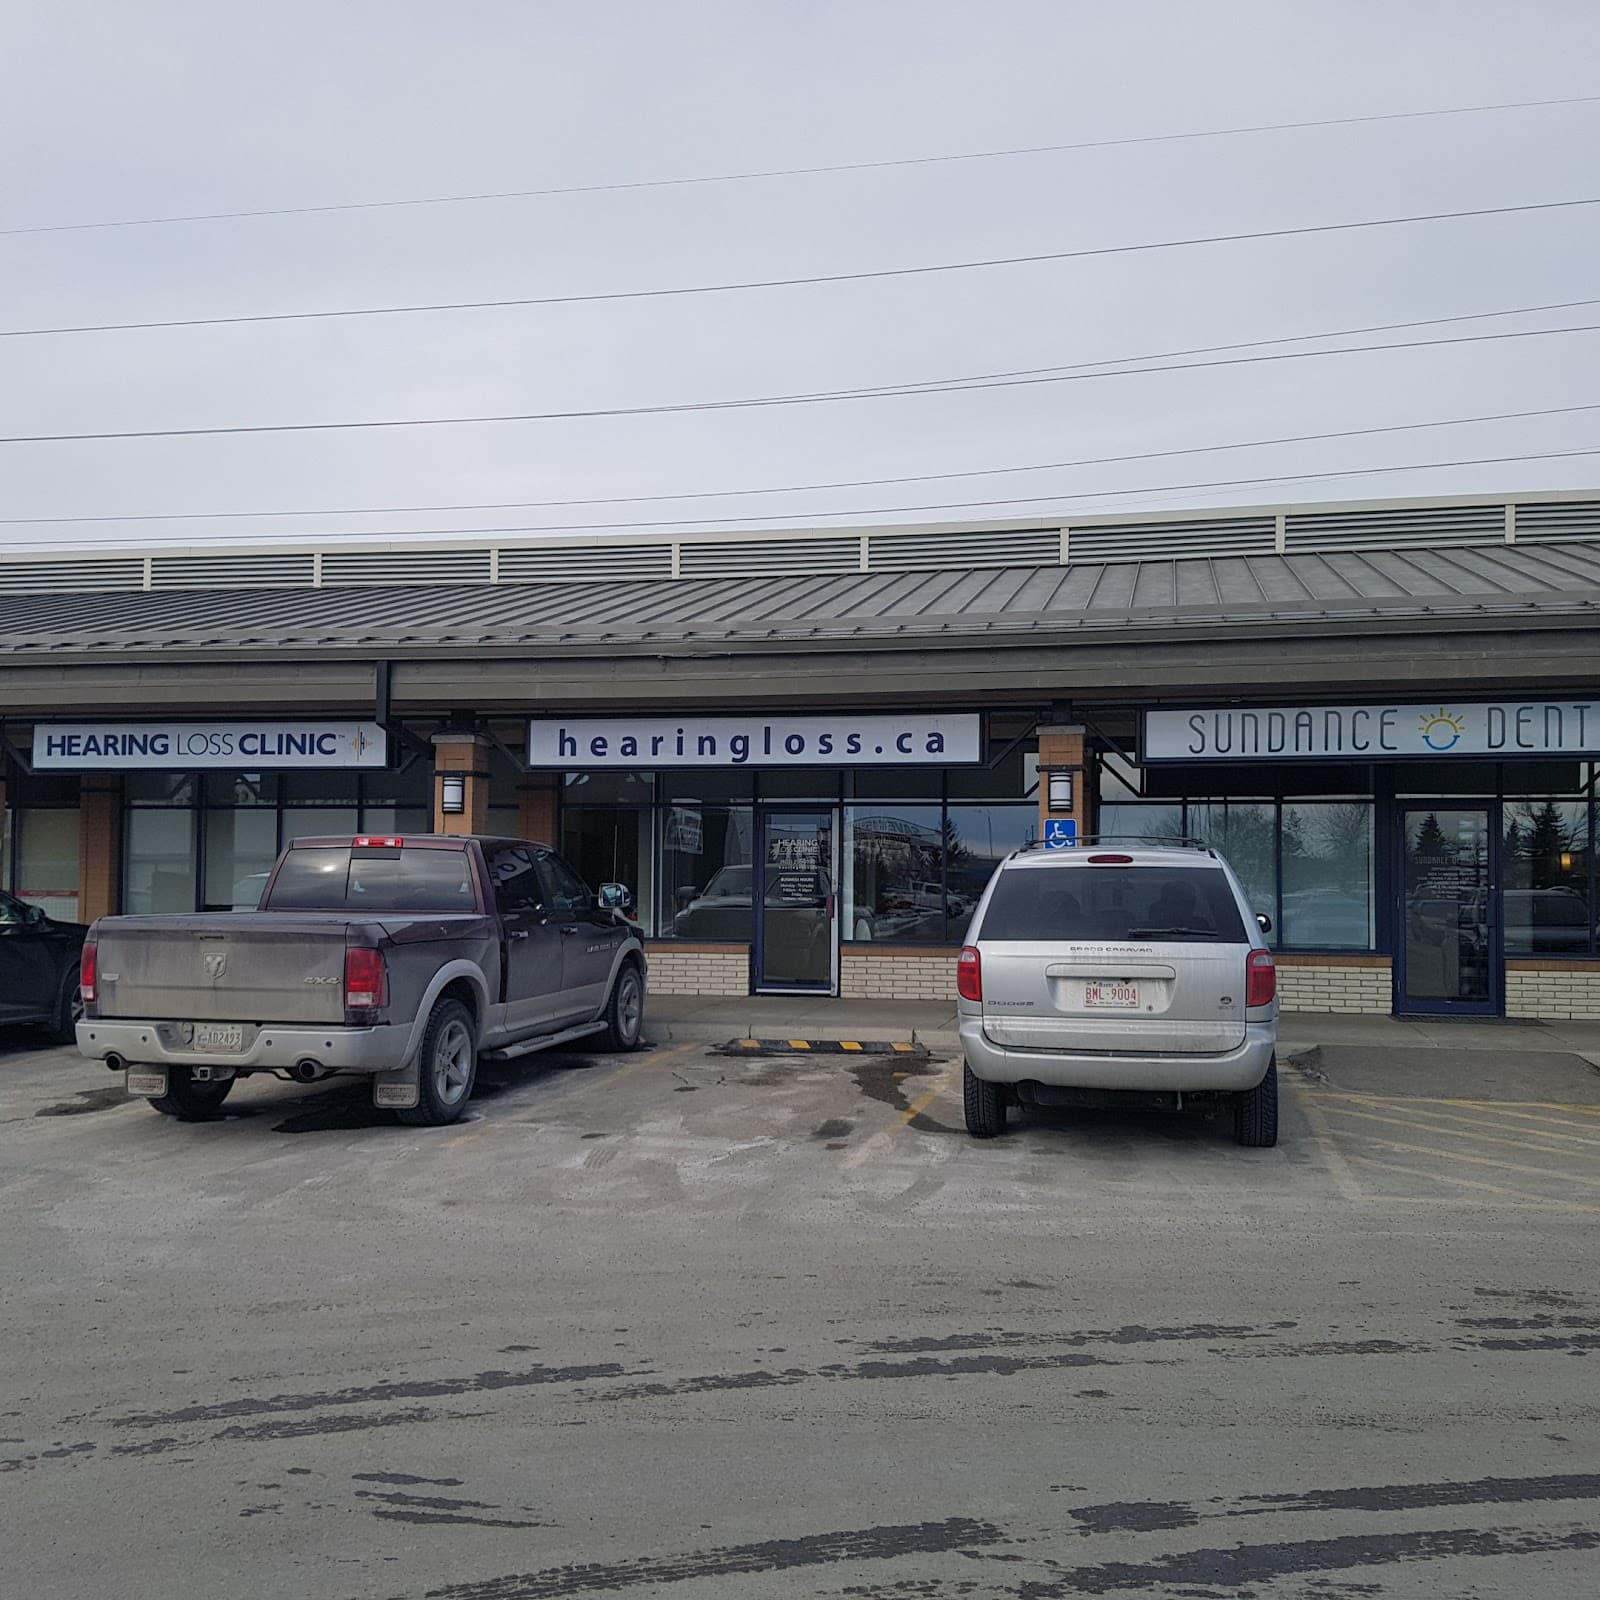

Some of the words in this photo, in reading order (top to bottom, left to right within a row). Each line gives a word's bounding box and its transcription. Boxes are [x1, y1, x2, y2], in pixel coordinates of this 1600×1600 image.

[1188, 709, 1399, 754] SUNDANCE
[1487, 704, 1591, 749] DENT
[46, 733, 170, 757] HEARING
[176, 733, 234, 756] LOSS
[238, 732, 338, 756] CLINIC
[558, 726, 946, 764] hearingloss.ca
[778, 839, 818, 847] HEARING
[1069, 945, 1104, 953] GRAND
[1105, 946, 1153, 954] CARAVAN
[1085, 987, 1137, 1001] BML-9004
